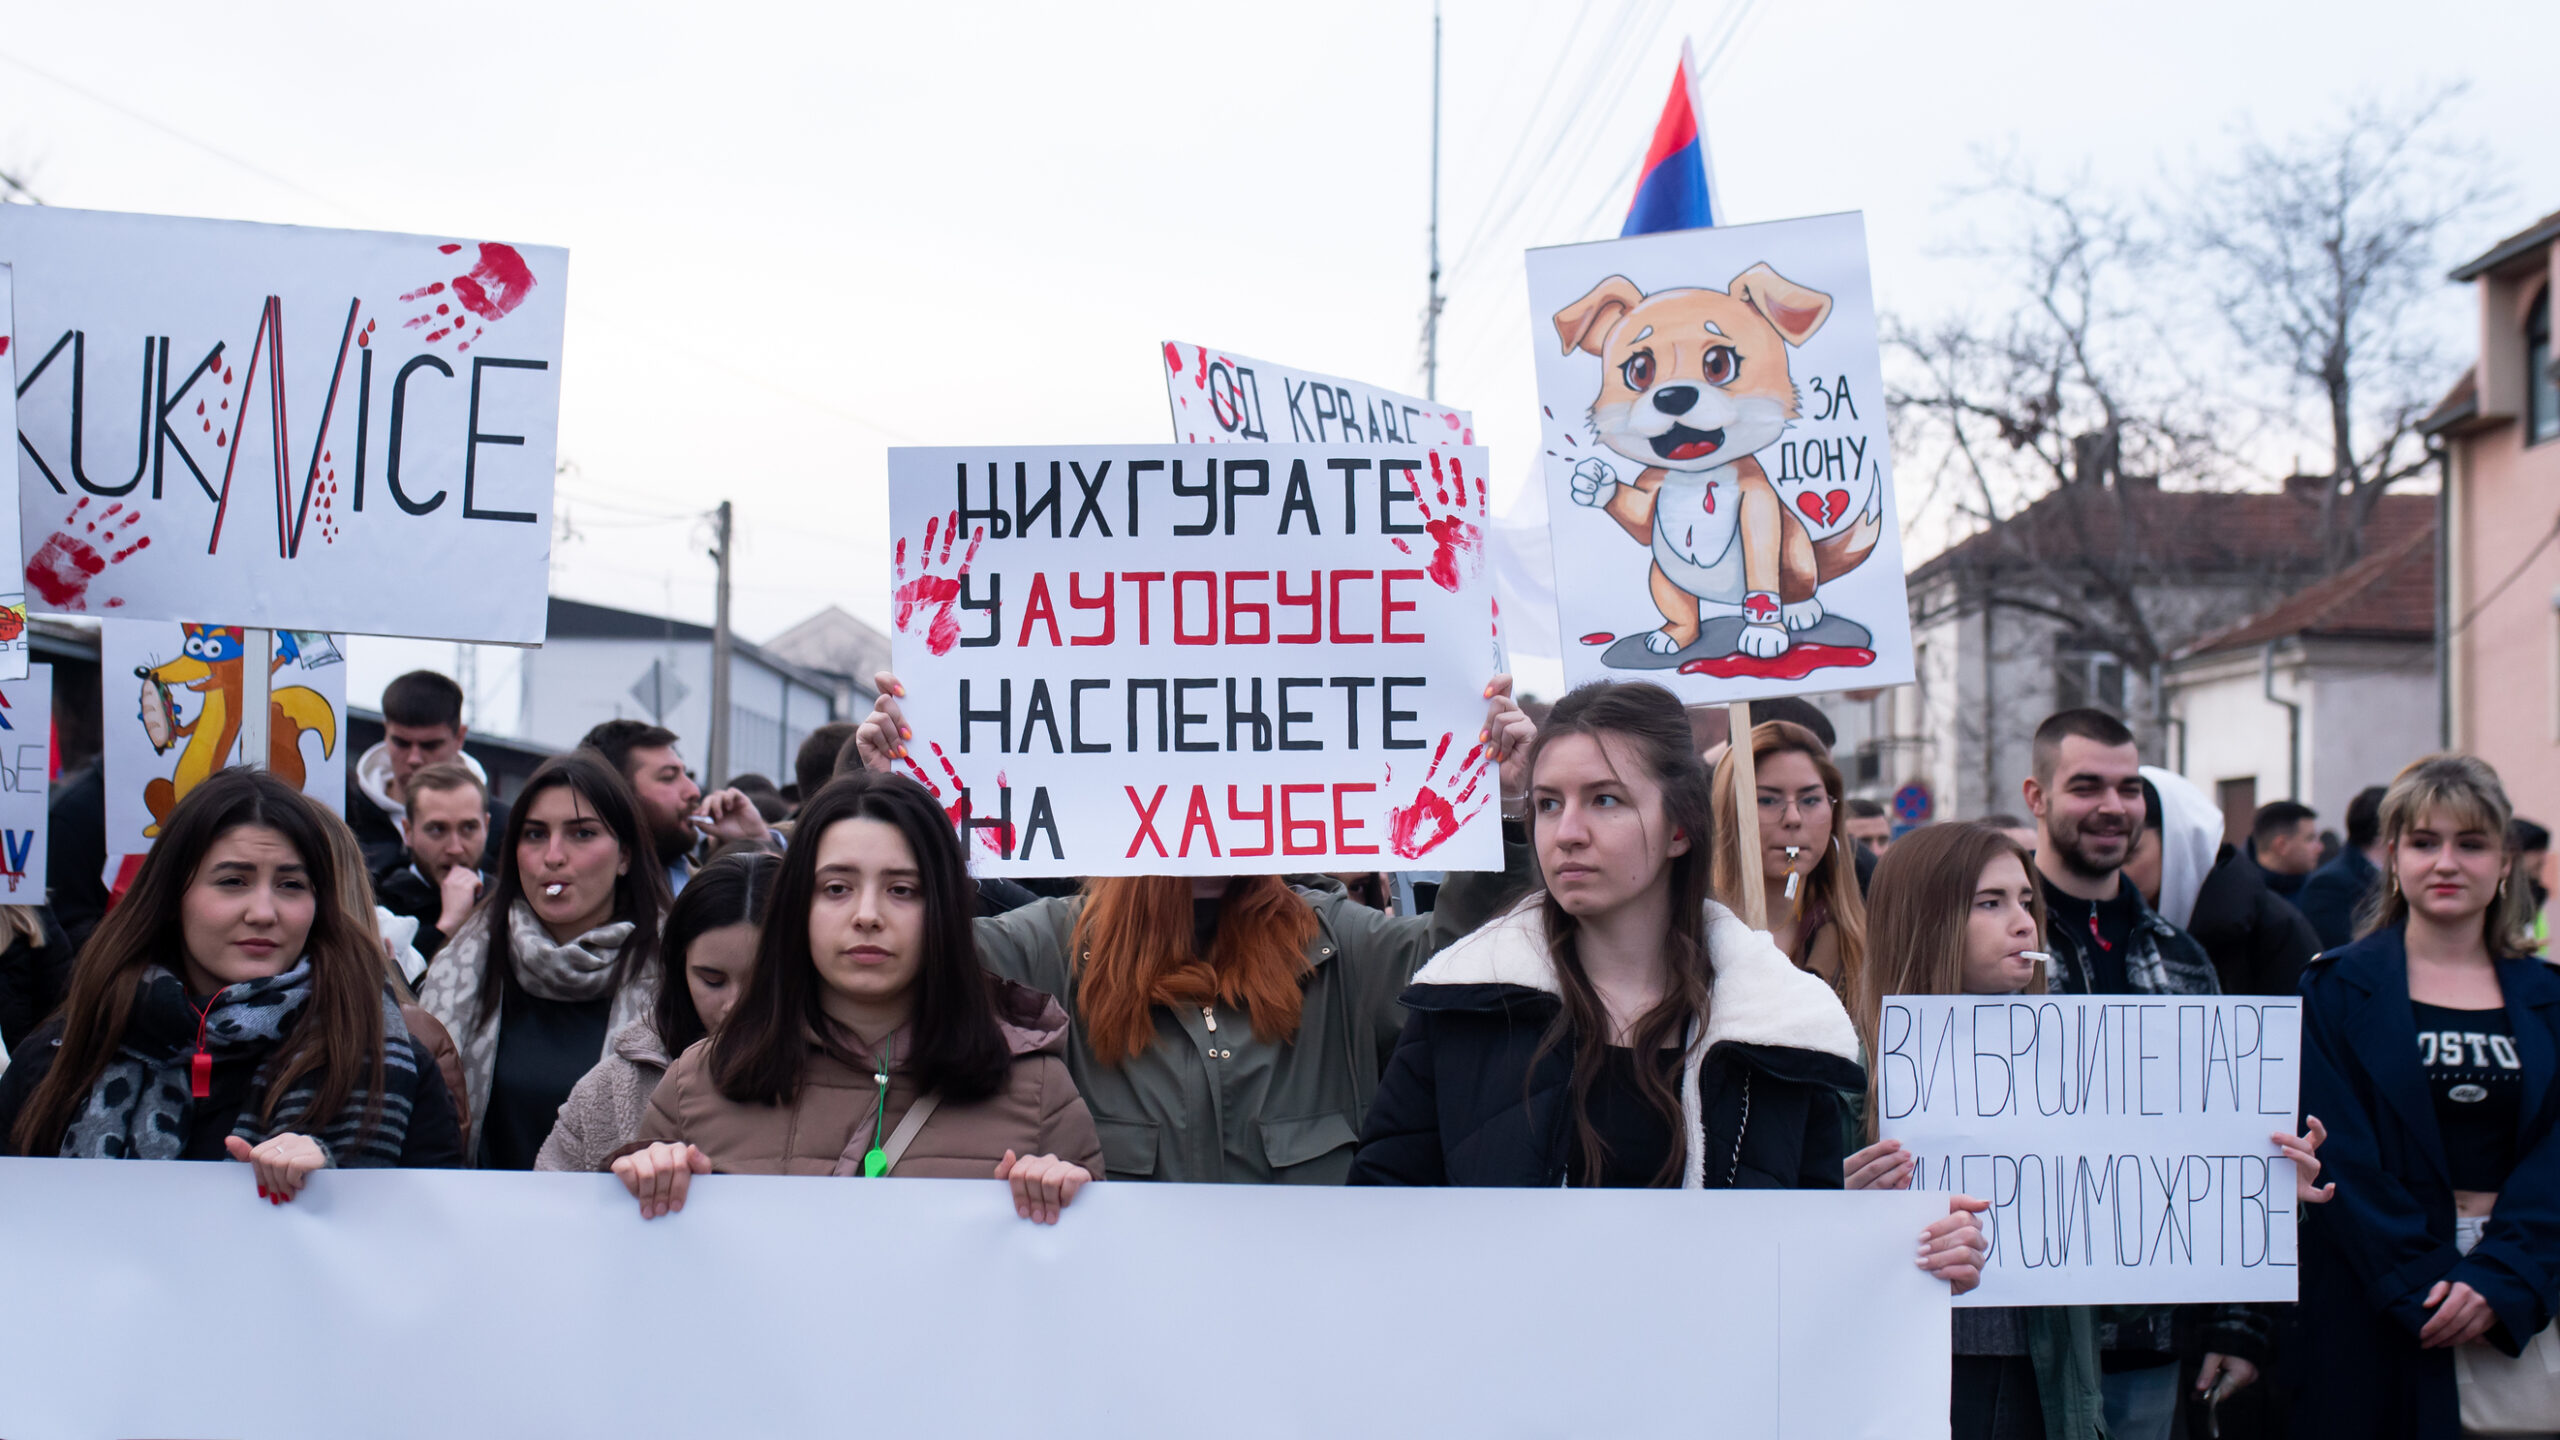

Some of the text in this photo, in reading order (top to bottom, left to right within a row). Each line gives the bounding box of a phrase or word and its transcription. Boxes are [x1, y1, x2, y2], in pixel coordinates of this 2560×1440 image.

[1208, 361, 1269, 443] ОД
[1809, 374, 1858, 421] ЗА
[1776, 435, 1867, 486] ДОНУ
[959, 569, 1426, 648] У АУТОБУСЕ
[960, 782, 1380, 861] НА ХАУБЕ
[1883, 1004, 1959, 1119] ВИ
[2178, 1004, 2298, 1115] ПАРЕ
[2418, 1030, 2521, 1069] OSTO
